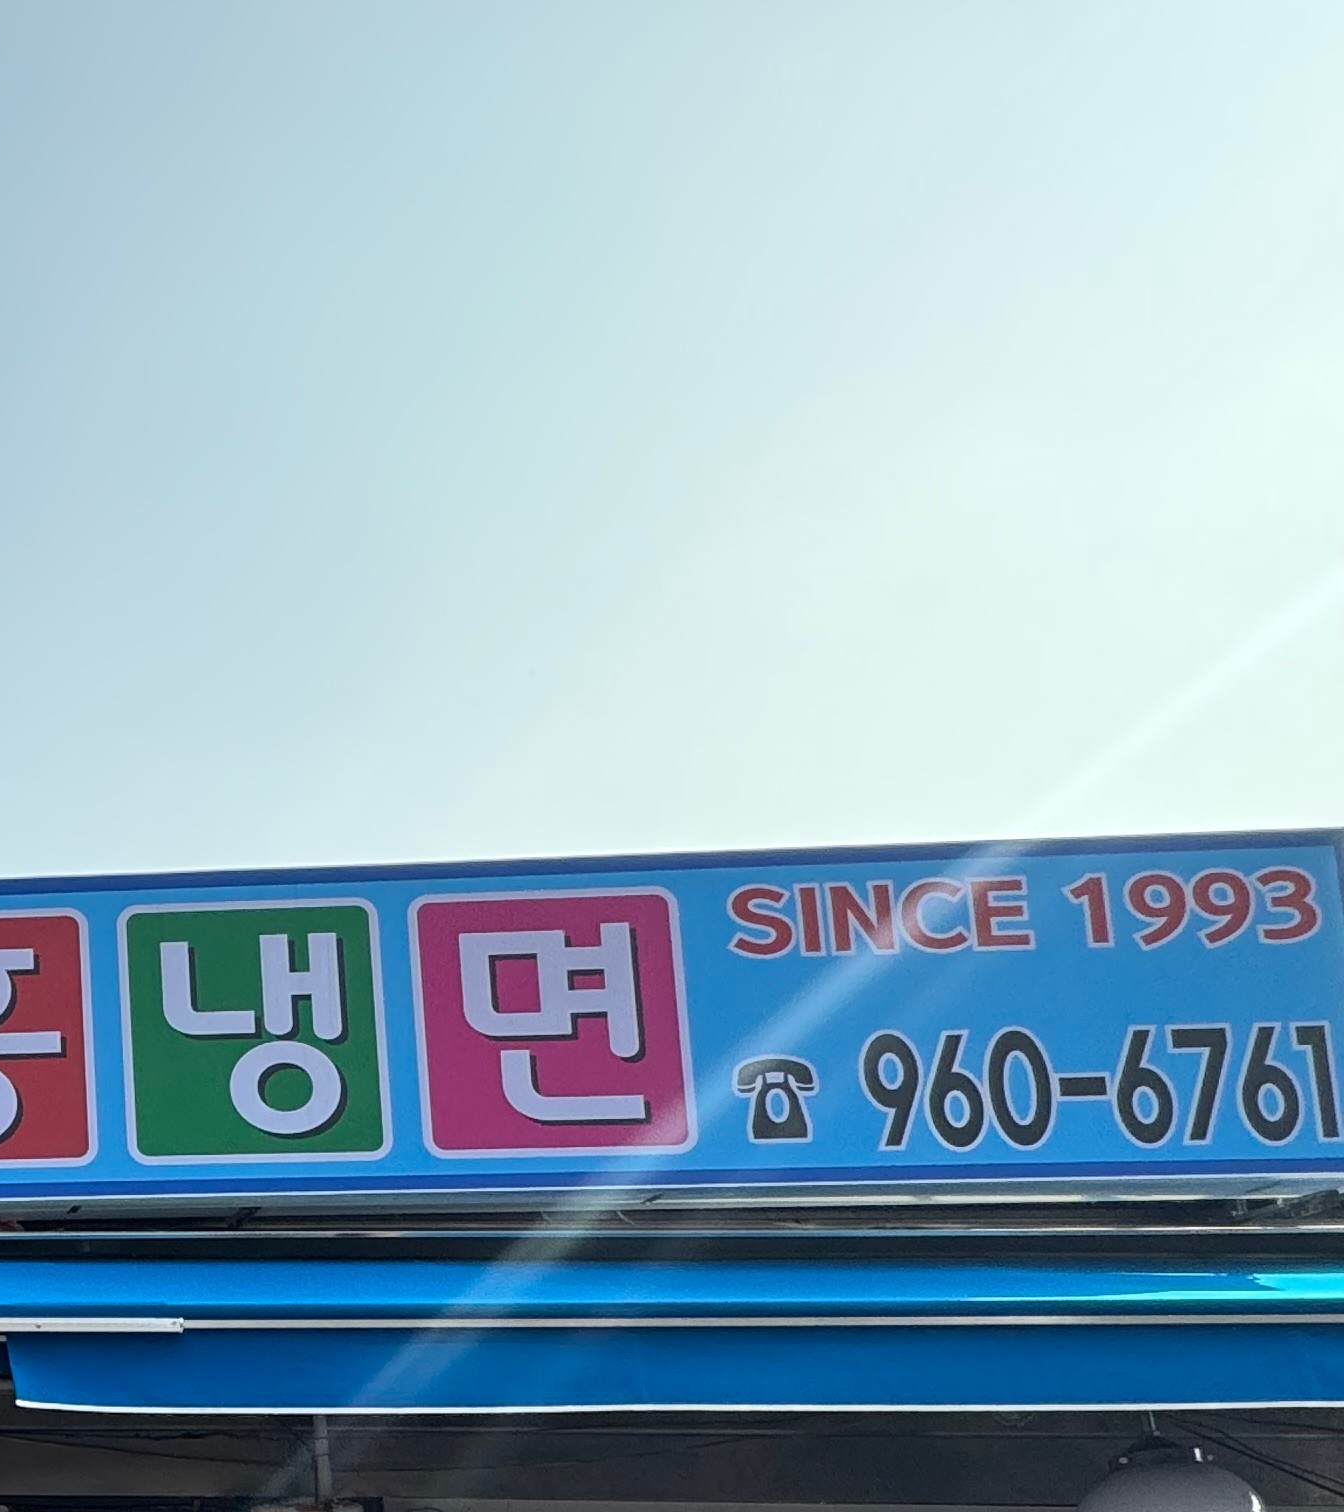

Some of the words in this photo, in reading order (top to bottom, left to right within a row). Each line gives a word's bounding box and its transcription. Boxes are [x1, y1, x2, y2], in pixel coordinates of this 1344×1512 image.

[727, 875, 1036, 958] SINCE
[1063, 865, 1322, 950] 1993
[859, 1021, 1343, 1152] 960-6761
